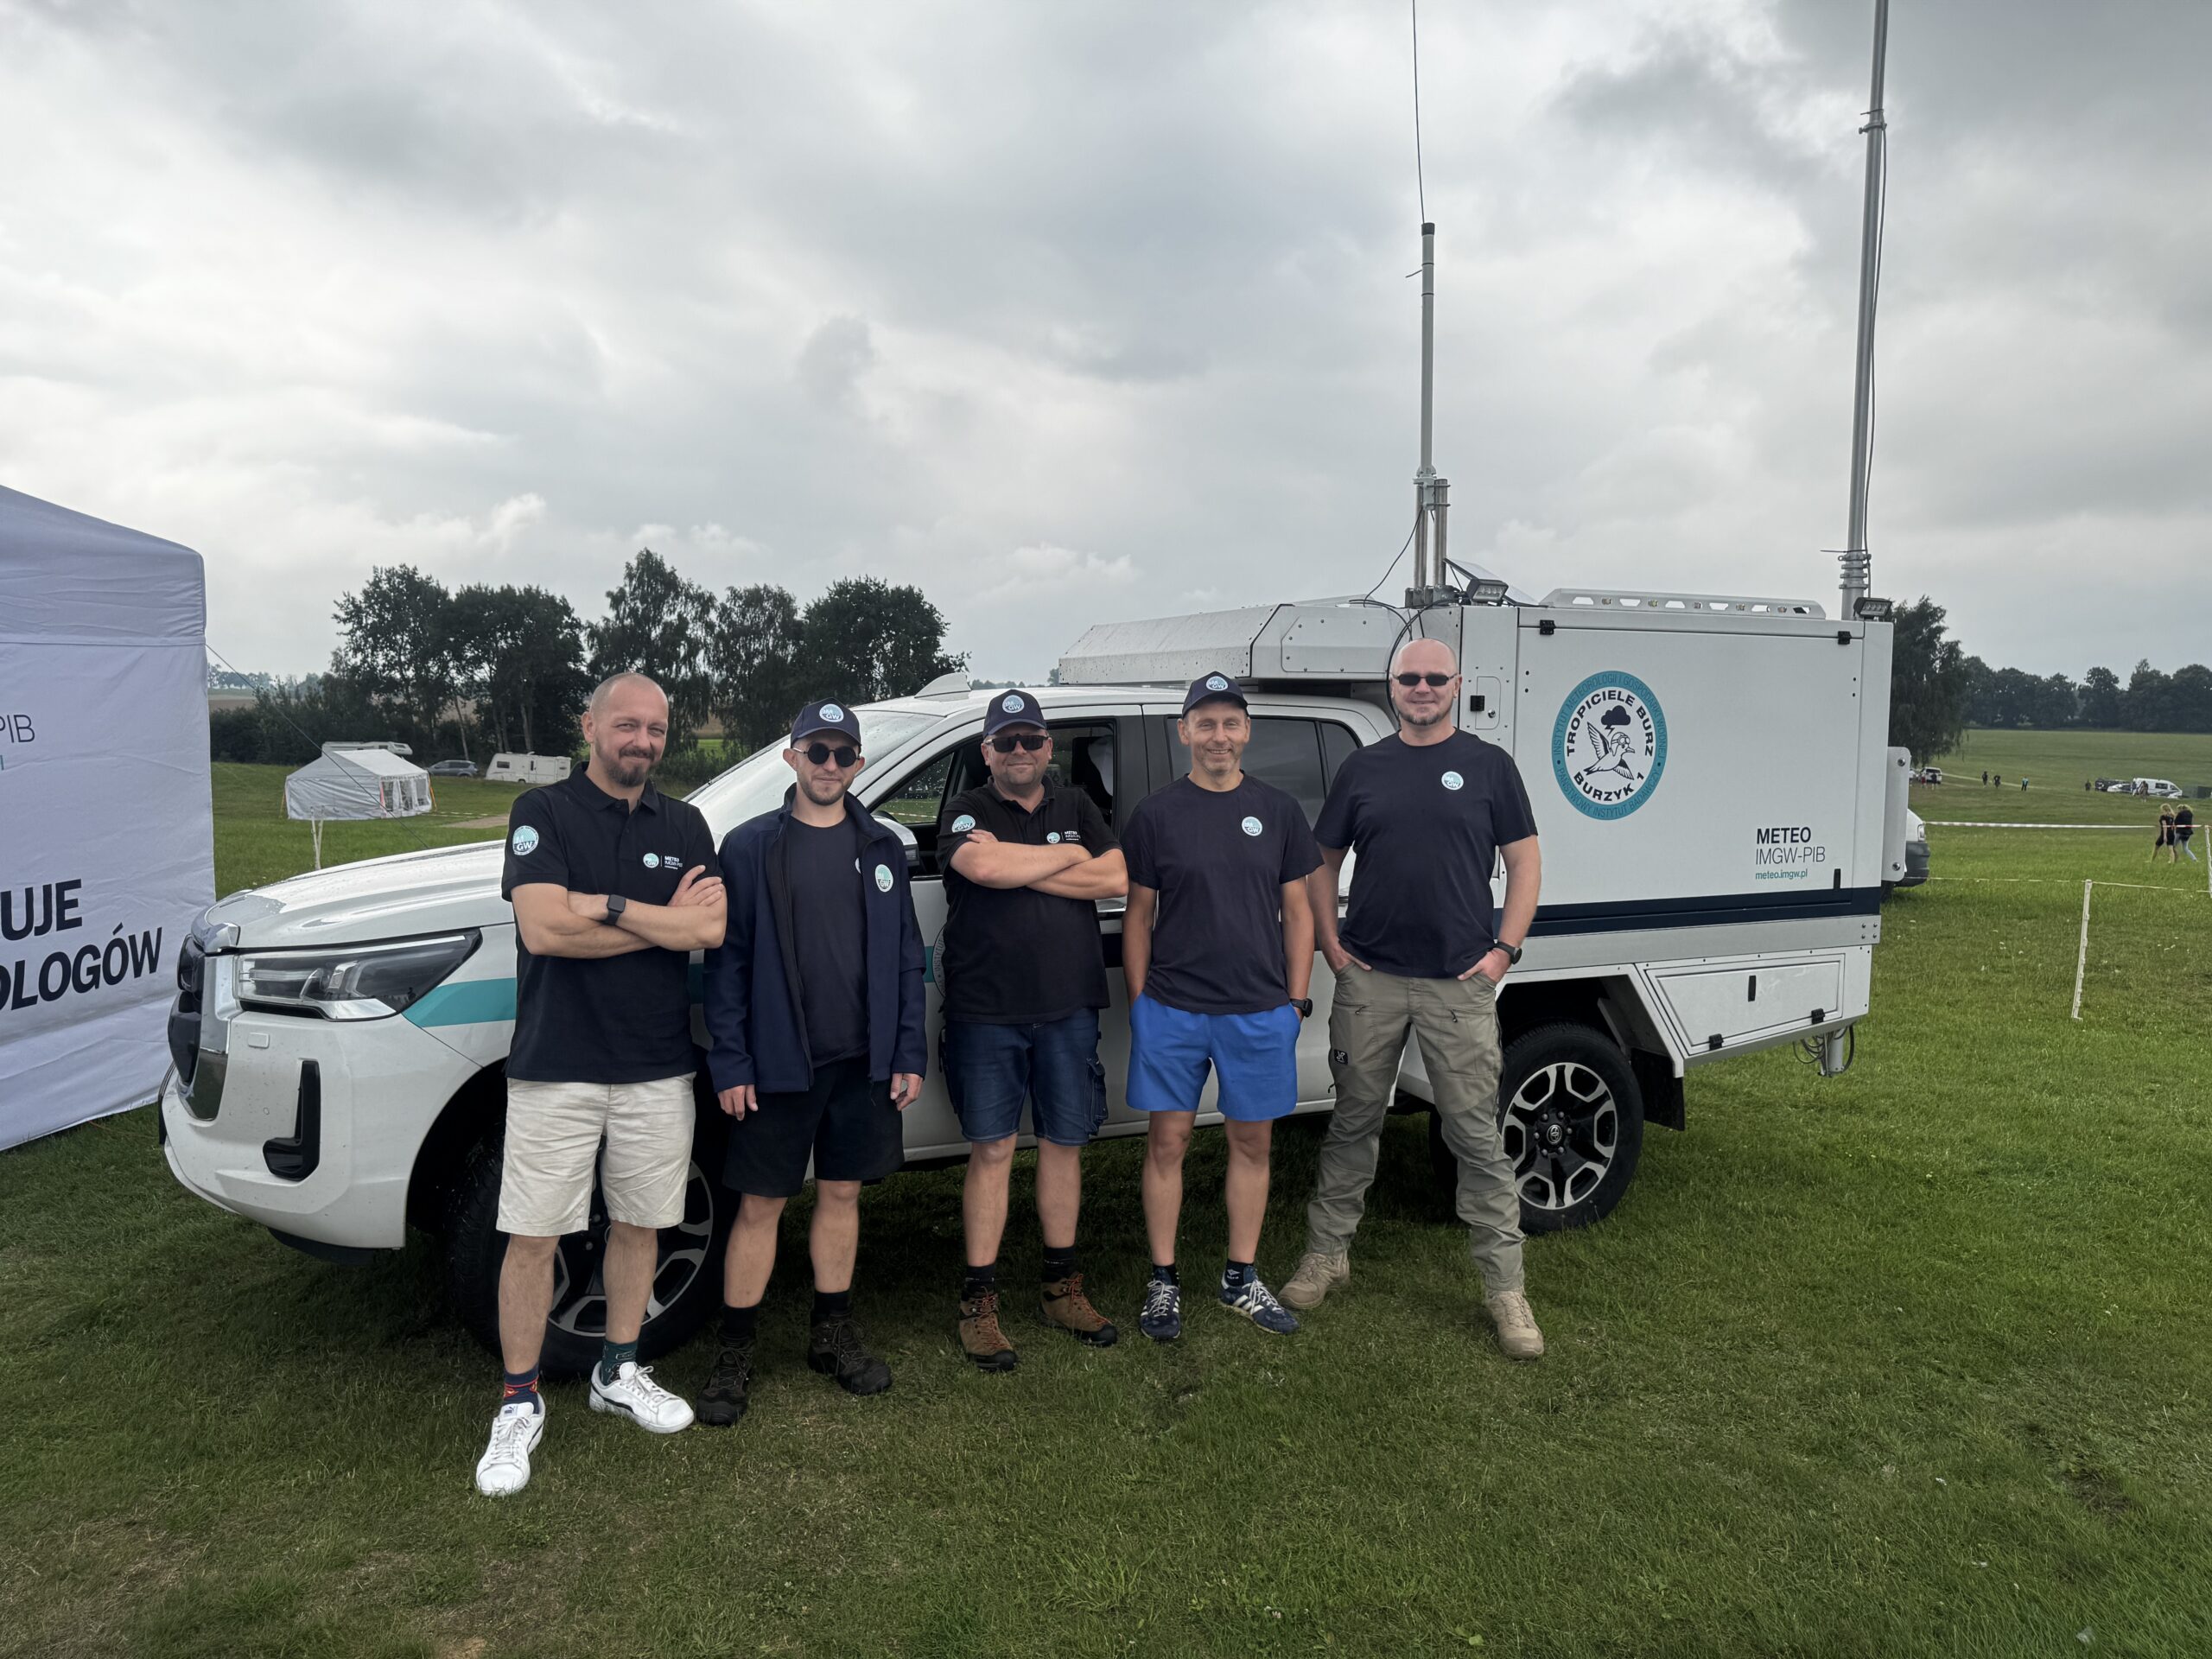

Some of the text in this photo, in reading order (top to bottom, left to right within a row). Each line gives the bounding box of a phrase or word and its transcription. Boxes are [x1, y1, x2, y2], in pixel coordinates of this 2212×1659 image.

[1554, 710, 1569, 754] INSTYTUT
[1567, 690, 1653, 757] TROPICIELE BURZ
[1573, 771, 1635, 801] BURZYK
[1757, 827, 1811, 844] METEO
[1756, 846, 1826, 865] IMGW-PIB
[1755, 868, 1808, 880] meteo.imgw.pl
[0, 879, 83, 941] UJE
